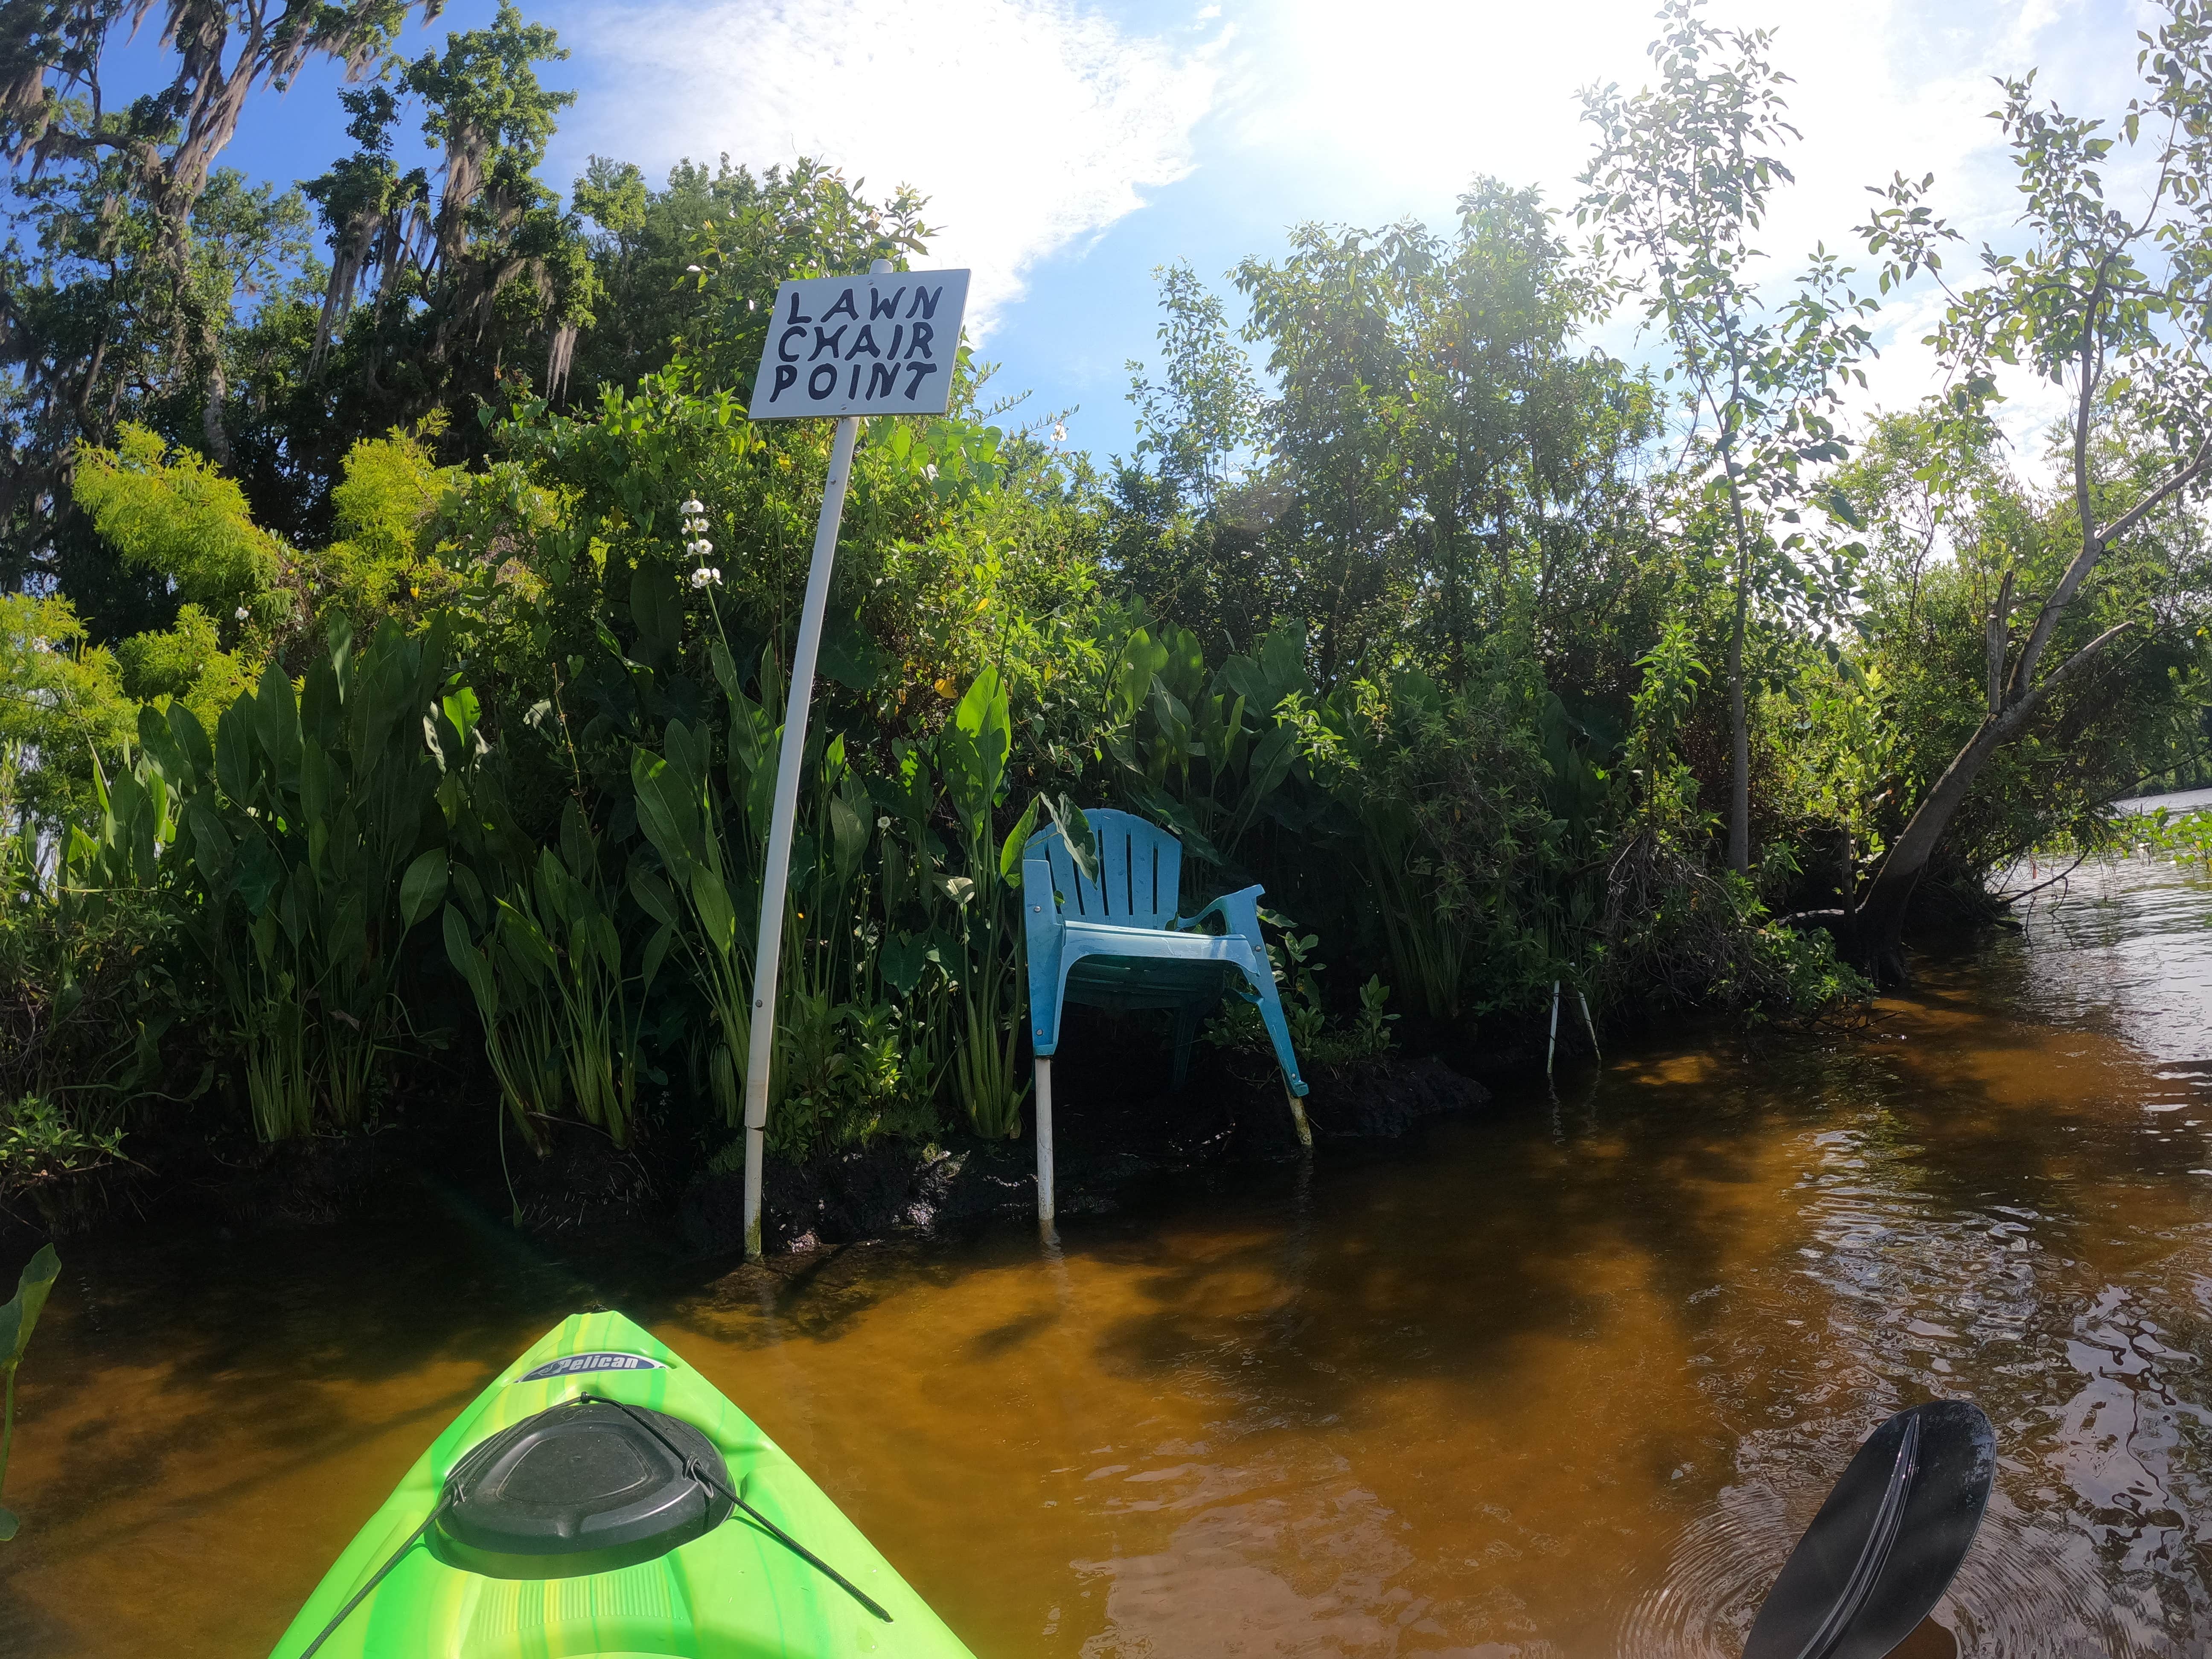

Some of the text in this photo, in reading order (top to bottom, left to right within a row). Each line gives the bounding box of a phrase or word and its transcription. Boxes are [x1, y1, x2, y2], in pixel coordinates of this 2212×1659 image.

[787, 285, 943, 325] LAWN
[778, 322, 934, 362] CHAIR
[769, 361, 937, 402] POINT
[558, 1355, 639, 1371] Pelican
